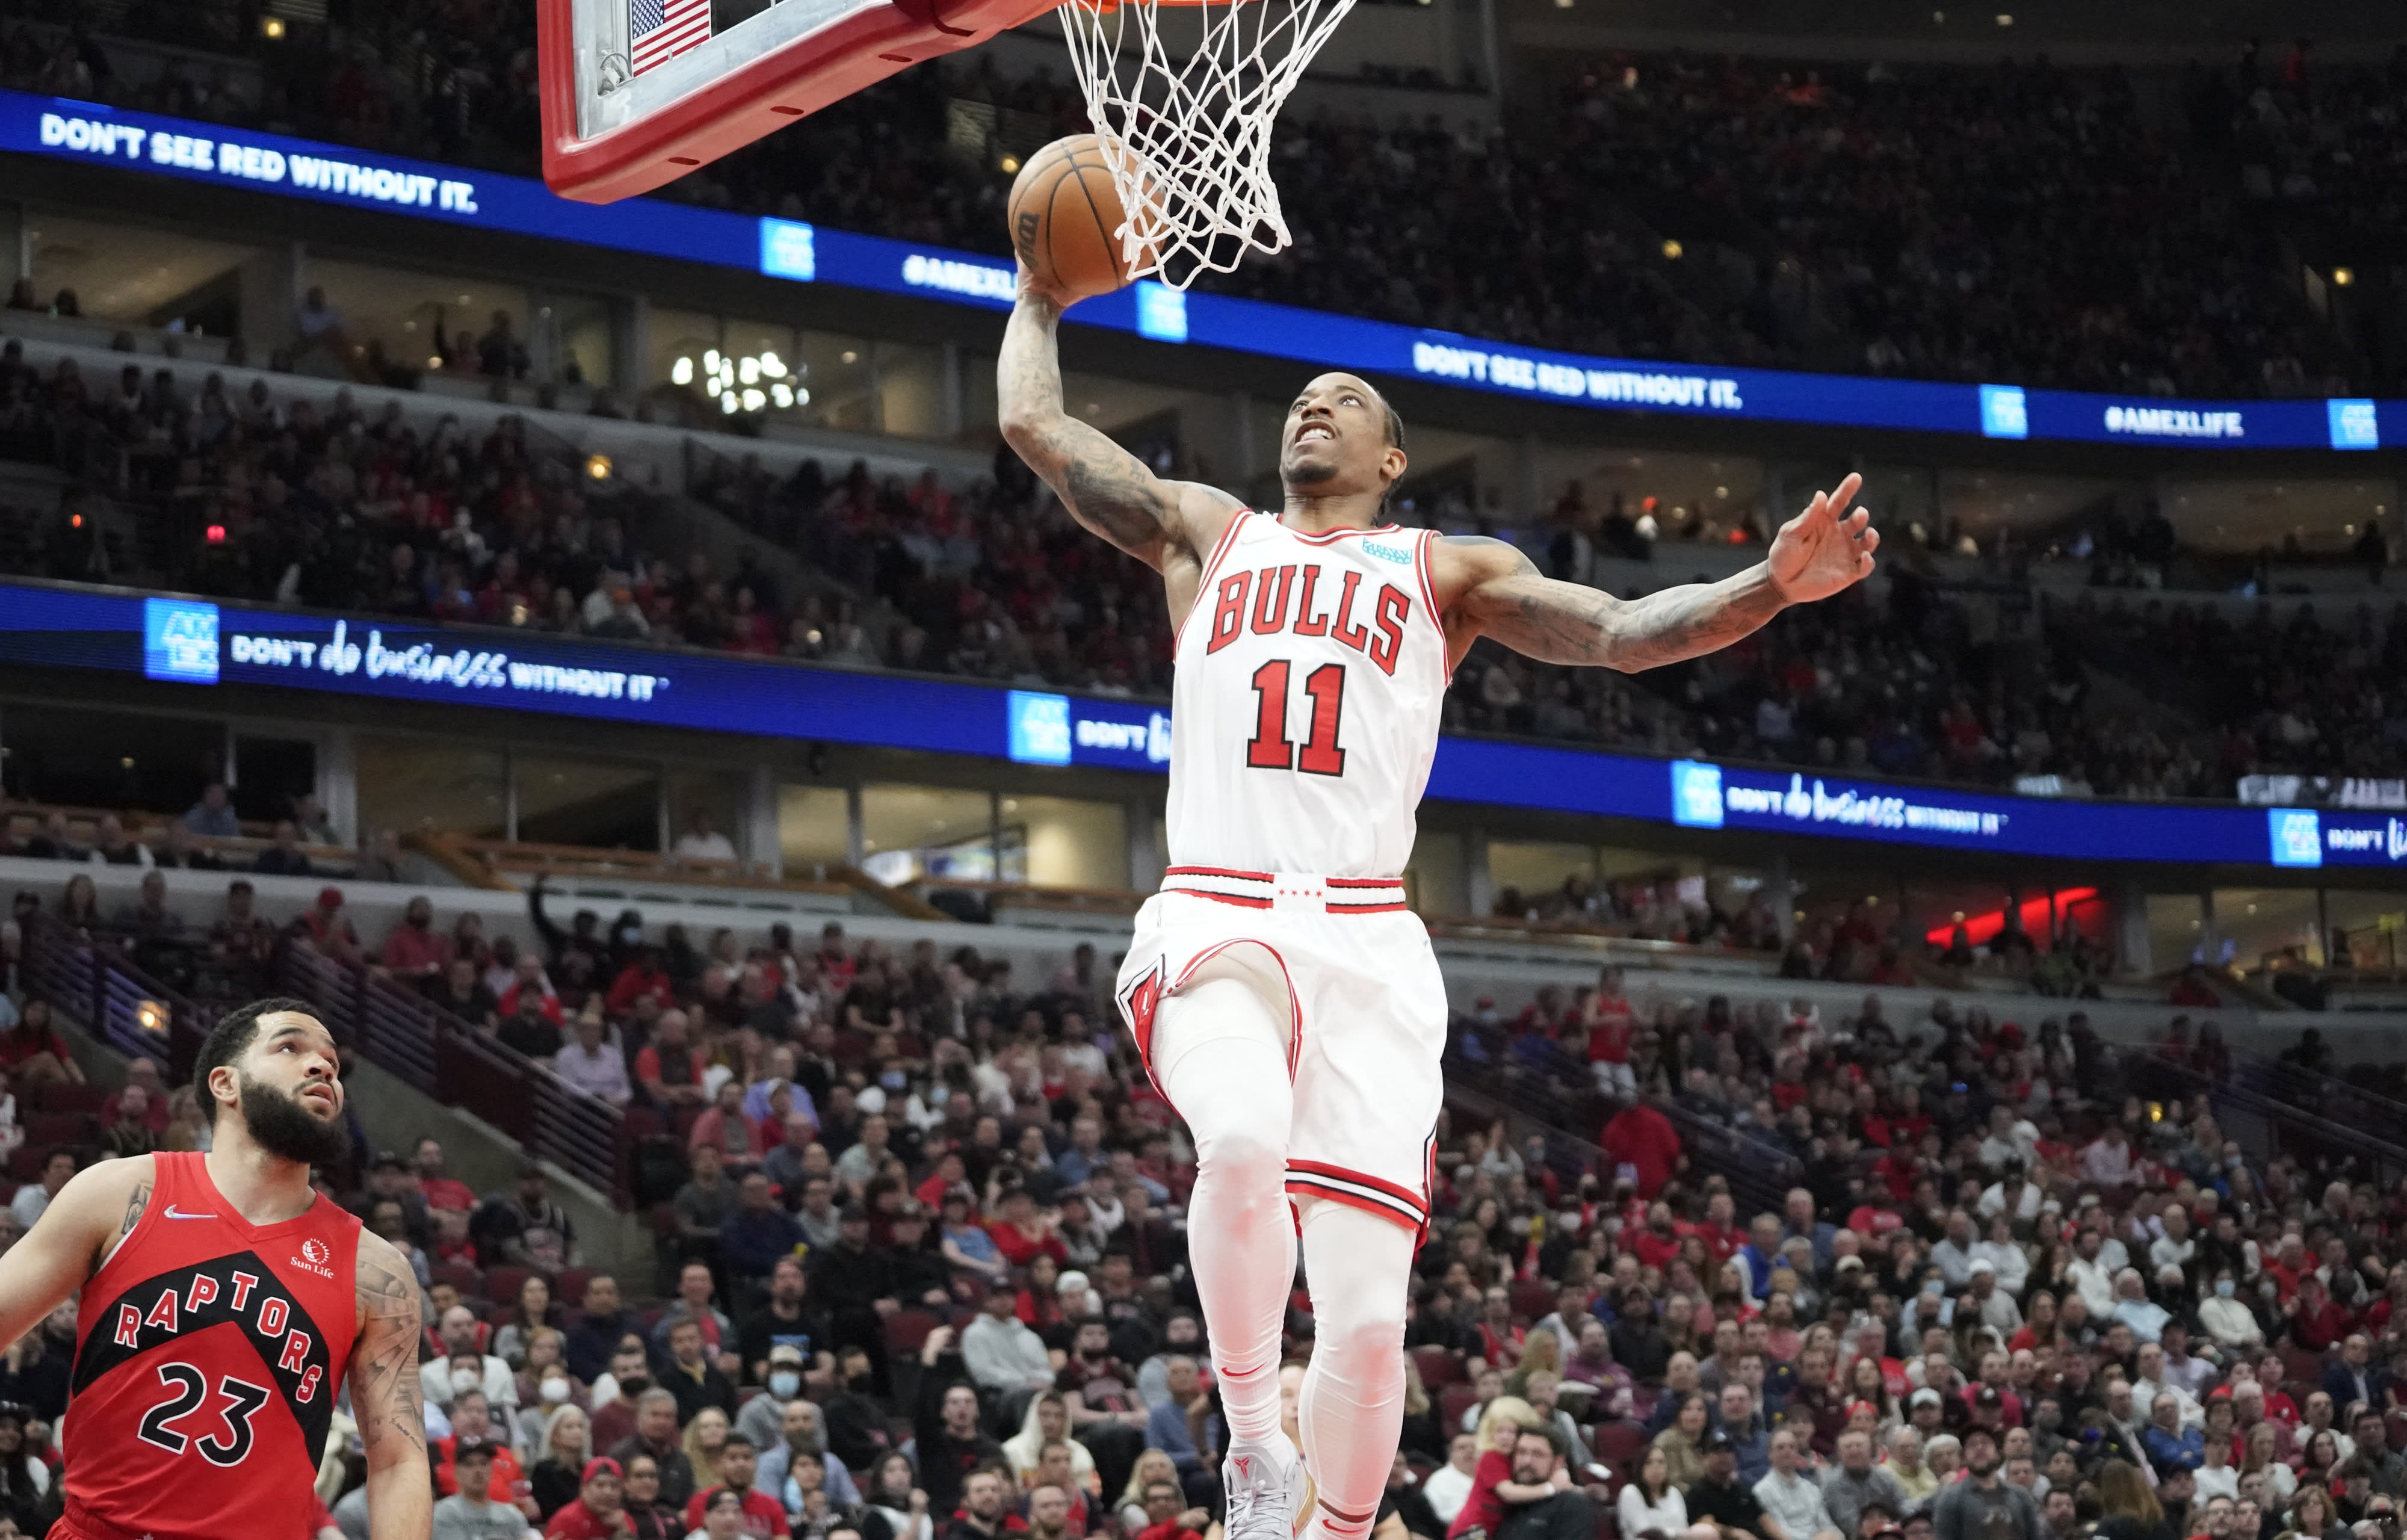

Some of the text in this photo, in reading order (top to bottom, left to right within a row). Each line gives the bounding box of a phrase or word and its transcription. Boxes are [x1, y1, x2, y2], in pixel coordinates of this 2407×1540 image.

[40, 113, 478, 215] DON'T SEE RED WITHOUT IT.
[1413, 341, 1743, 410] DON'T SEE RED WITHOUT IT.
[231, 635, 317, 668] DON'T
[320, 619, 361, 675] do
[366, 629, 507, 688] business
[507, 662, 627, 699] WITHOUT
[1207, 564, 1411, 677] BULLS
[1077, 720, 1146, 751] DON'T
[1246, 659, 1346, 778] 11
[1726, 787, 1783, 815] DON'T
[1783, 773, 1812, 820] do
[1905, 805, 1980, 834] WITHOUT
[2328, 829, 2385, 851] DON'T
[291, 1256, 334, 1279] Sun Life
[114, 1270, 322, 1403] RAPTORS
[137, 1362, 271, 1467] 23
